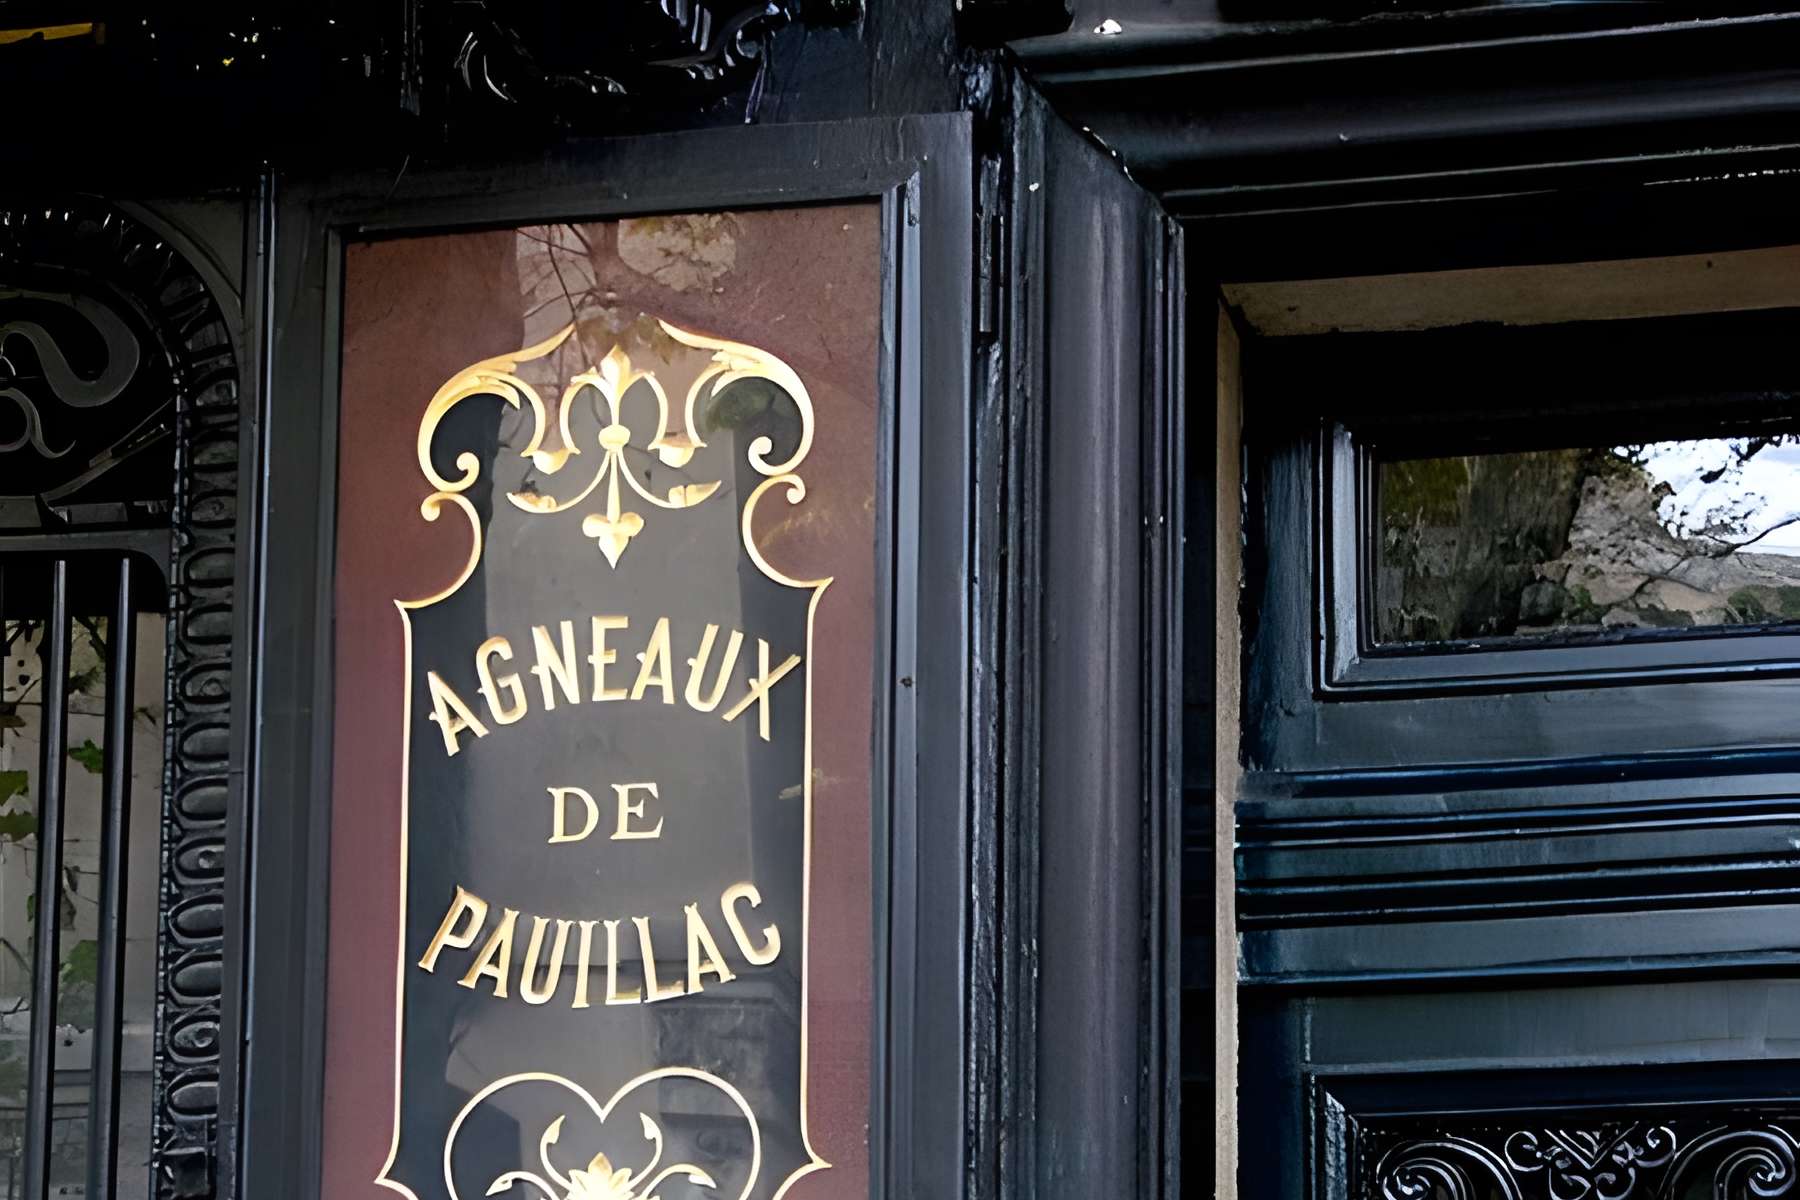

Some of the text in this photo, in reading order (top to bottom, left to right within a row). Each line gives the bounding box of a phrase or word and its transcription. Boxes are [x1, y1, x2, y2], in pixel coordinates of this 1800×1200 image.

[427, 616, 801, 756] AGNEAUX
[547, 782, 664, 843] DE
[418, 881, 781, 1008] PAUILLAC
